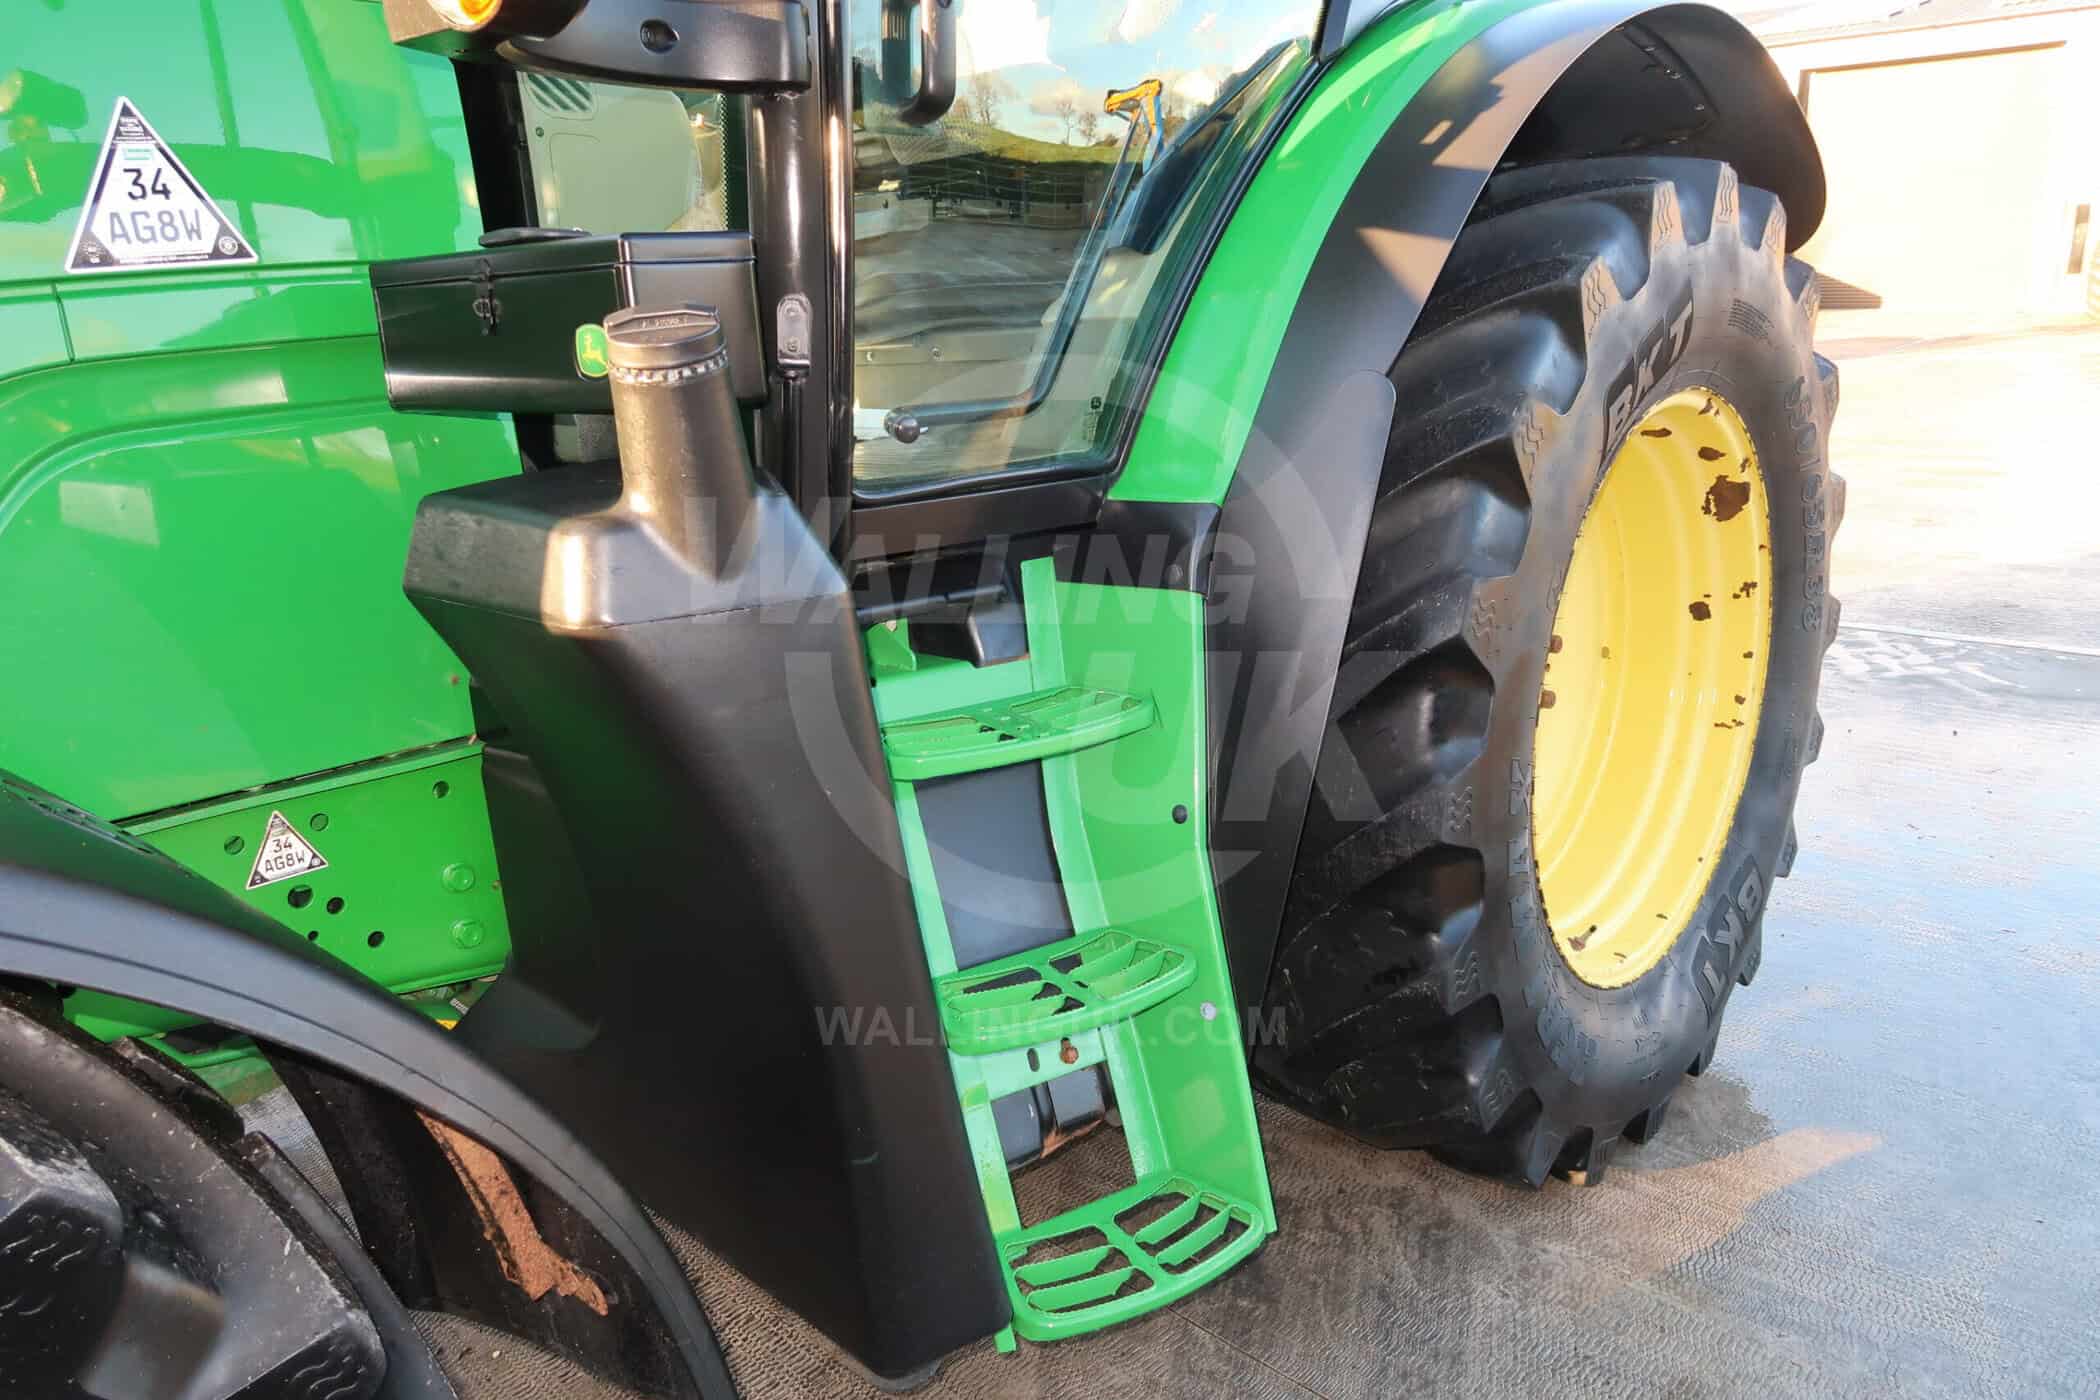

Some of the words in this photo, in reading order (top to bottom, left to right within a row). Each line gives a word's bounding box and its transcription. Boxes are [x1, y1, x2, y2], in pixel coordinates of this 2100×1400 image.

[123, 168, 172, 201] 34
[109, 208, 203, 245] AG8W
[1606, 299, 1693, 454] BKT
[265, 850, 305, 872] AG8W
[272, 837, 292, 853] 34
[1702, 866, 1764, 1000] BKT
